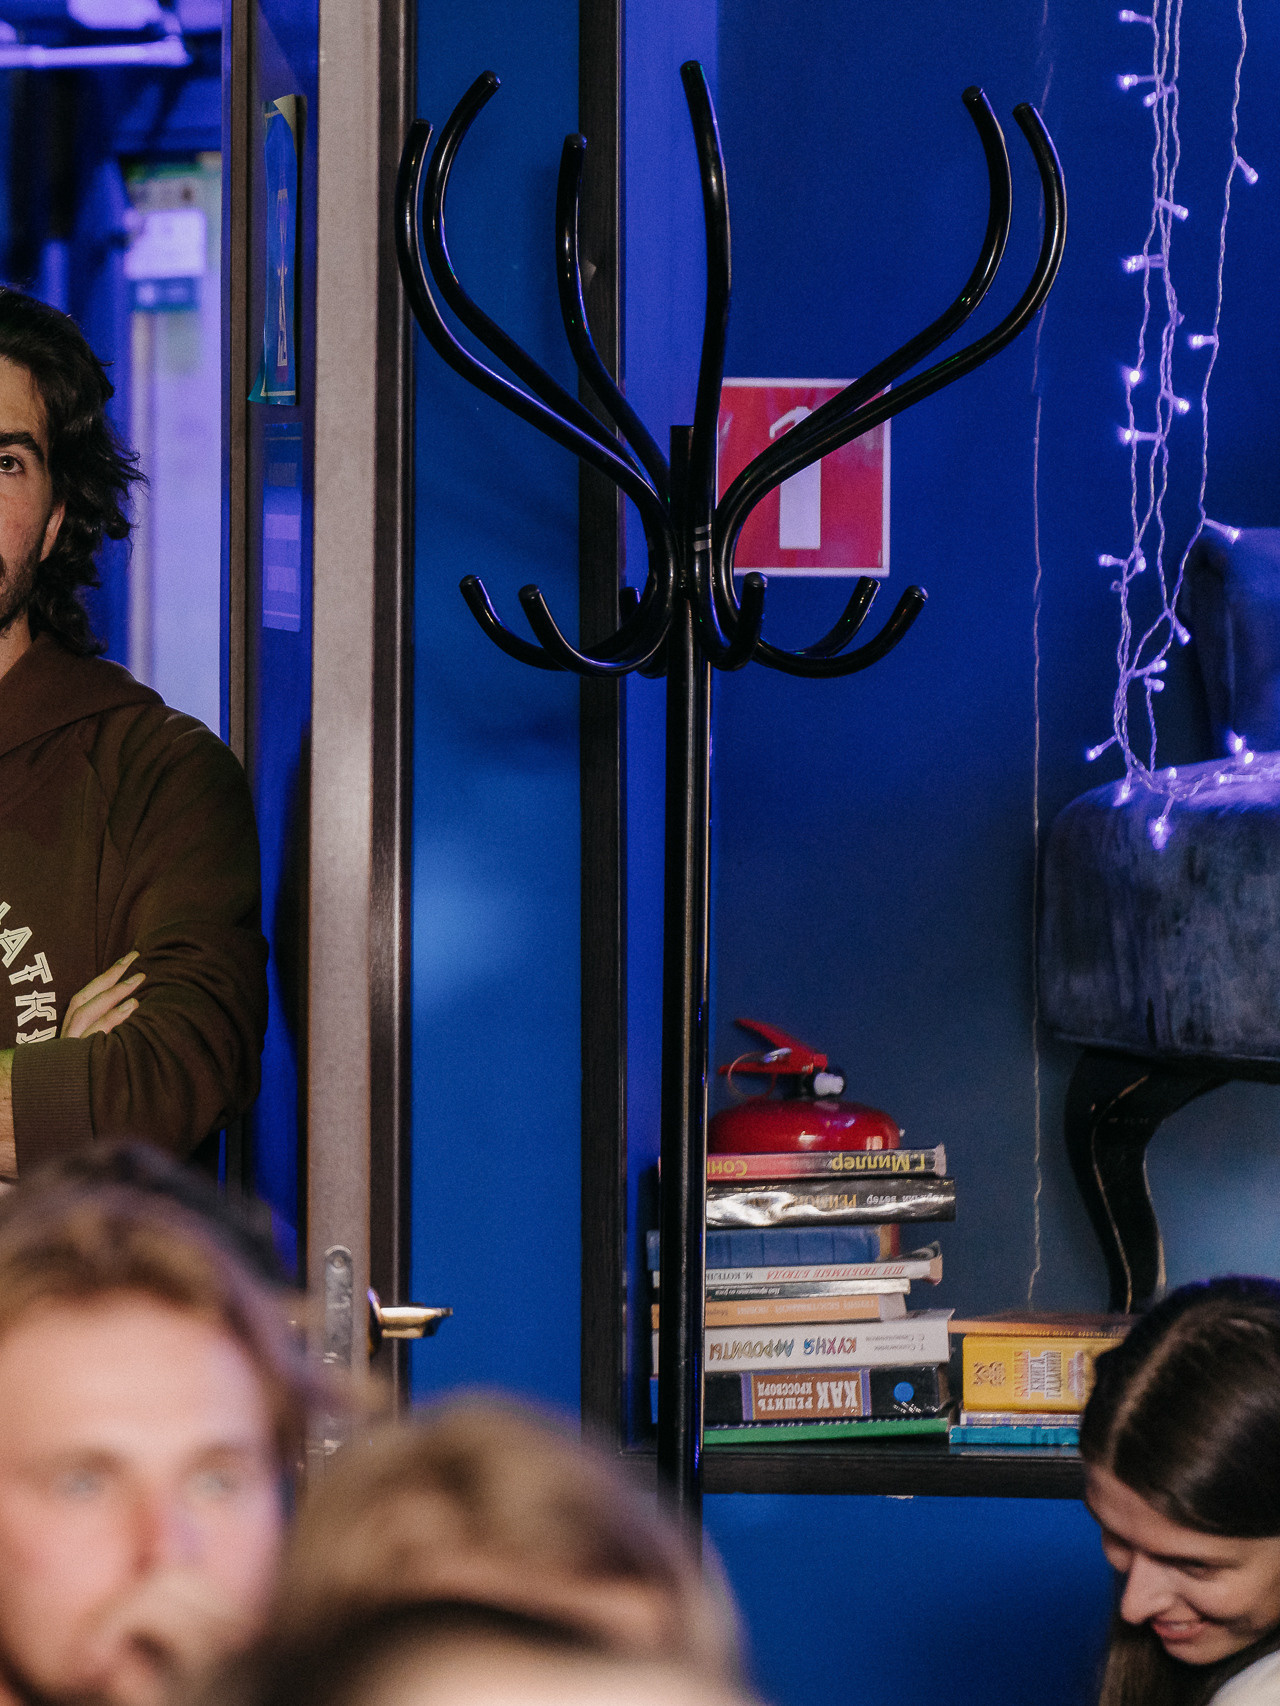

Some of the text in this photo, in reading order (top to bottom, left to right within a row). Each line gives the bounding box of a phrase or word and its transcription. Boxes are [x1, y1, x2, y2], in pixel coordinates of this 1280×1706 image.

[765, 1268, 810, 1281] БЛЮДА
[709, 1336, 857, 1361] КУХНЯ АФРОДИТЫ
[757, 1381, 813, 1397] КРОССВОРД
[815, 1380, 858, 1410] КАК
[757, 1397, 813, 1412] РЕШИТЬ
